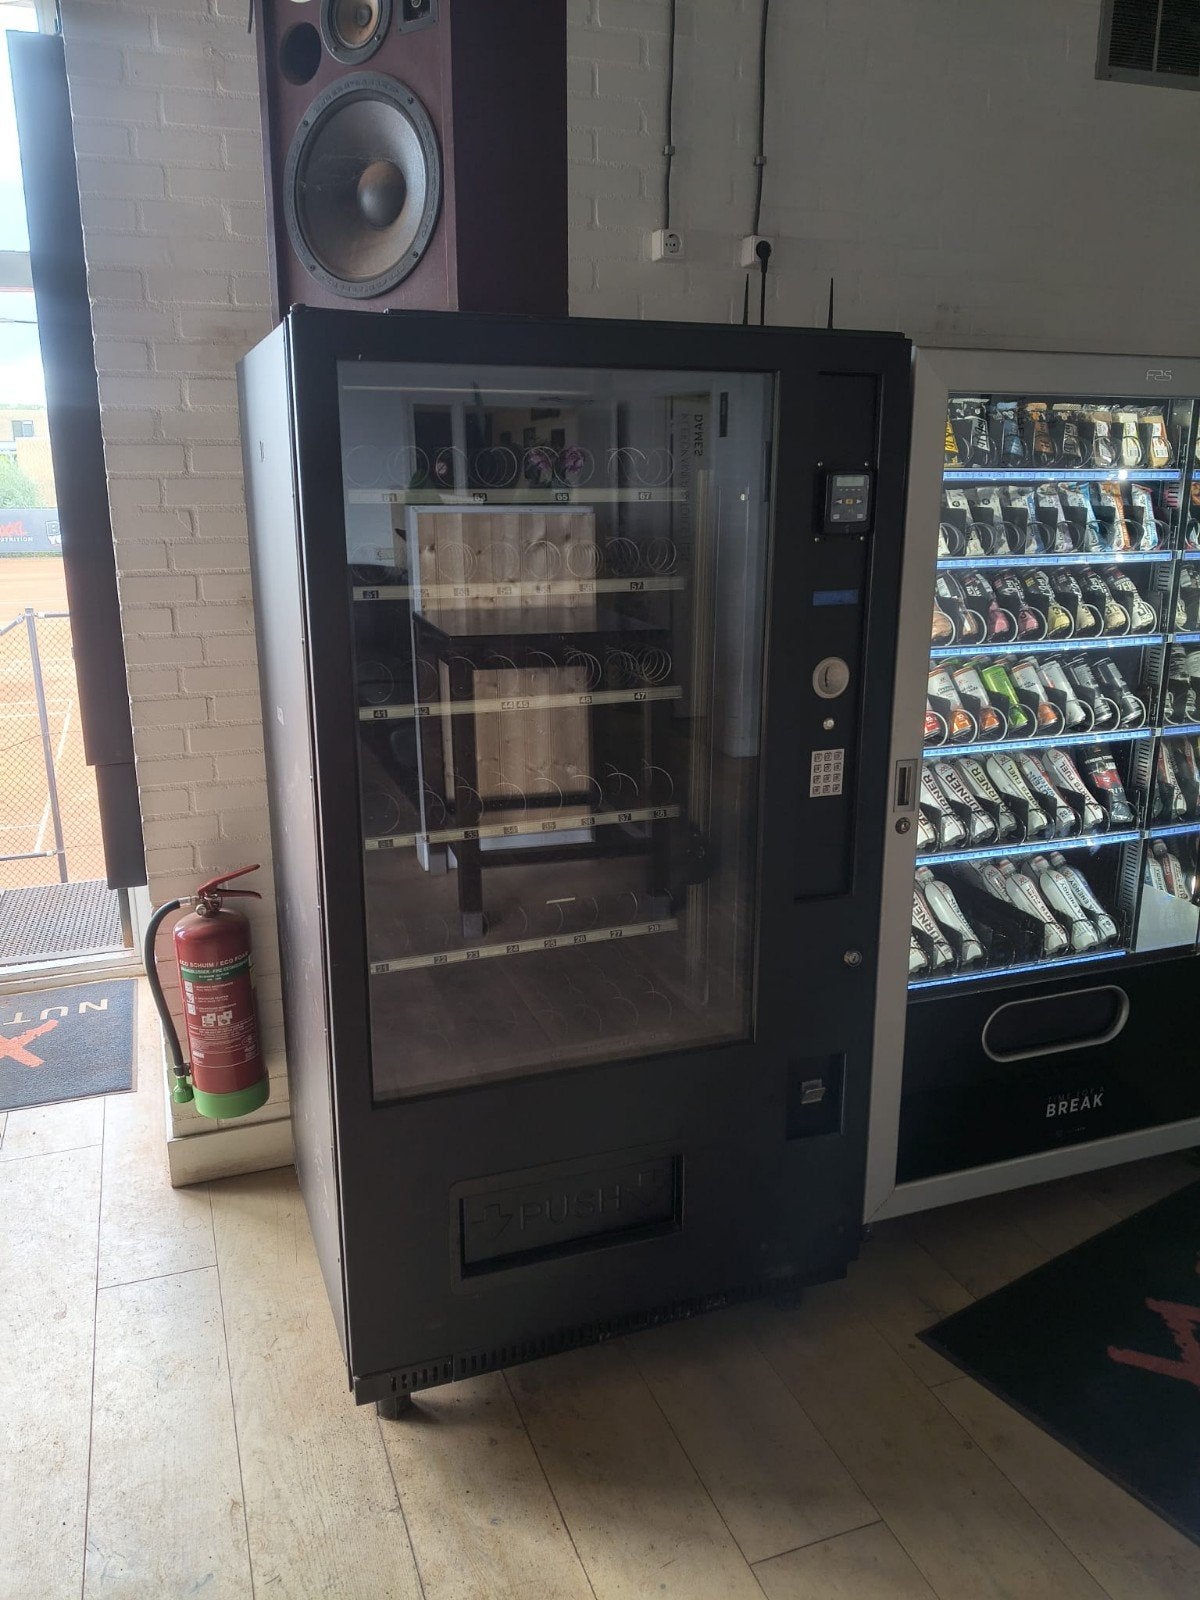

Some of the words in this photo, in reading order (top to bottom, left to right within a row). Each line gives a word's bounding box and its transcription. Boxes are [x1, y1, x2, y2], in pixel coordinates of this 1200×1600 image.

[220, 957, 234, 966] ECO
[1046, 1092, 1104, 1118] BREAK
[518, 1183, 620, 1232] PUSH
